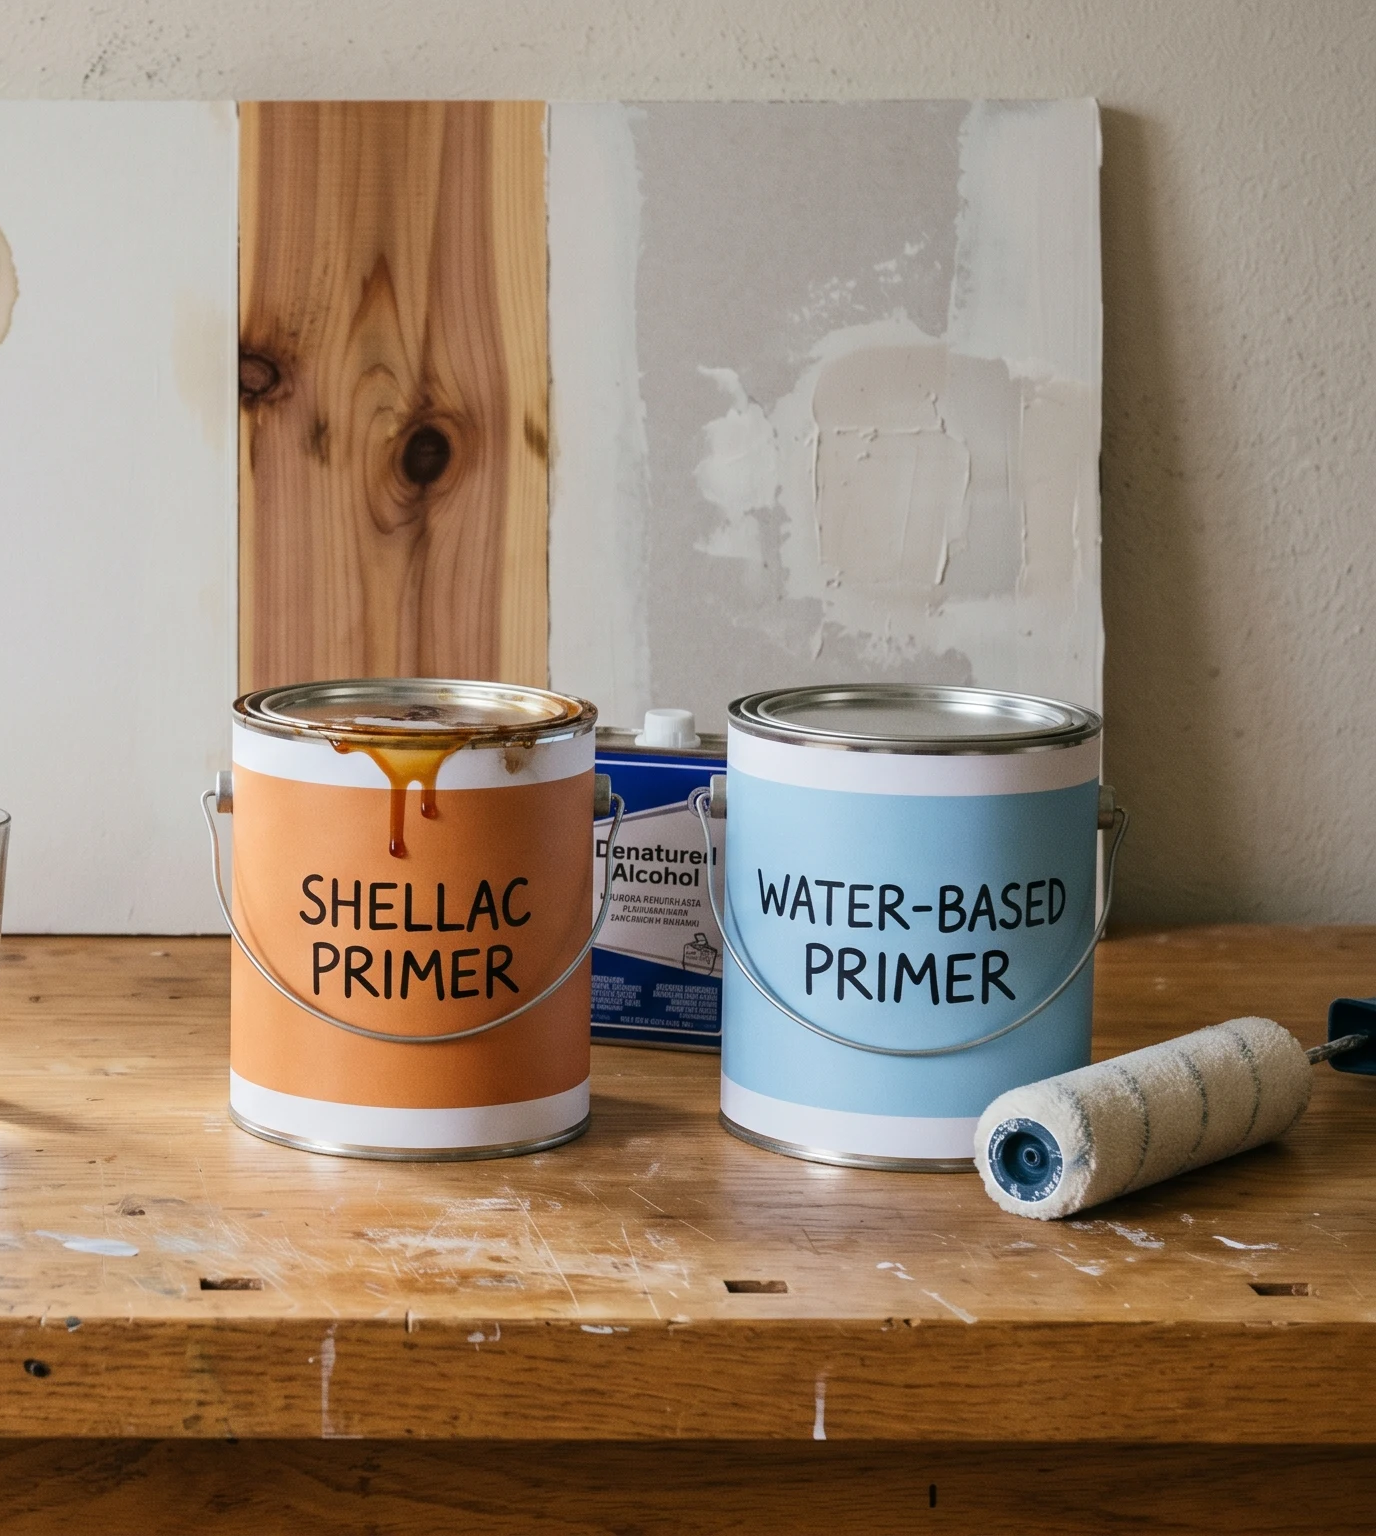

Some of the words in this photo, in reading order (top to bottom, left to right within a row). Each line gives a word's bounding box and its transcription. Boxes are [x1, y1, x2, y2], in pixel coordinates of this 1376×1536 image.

[299, 873, 532, 932] SHELLAC
[611, 863, 699, 887] Alcohol
[758, 868, 1066, 933] WATER-BASED
[313, 942, 519, 1001] PRIMER
[806, 942, 1016, 1005] PRIMER
